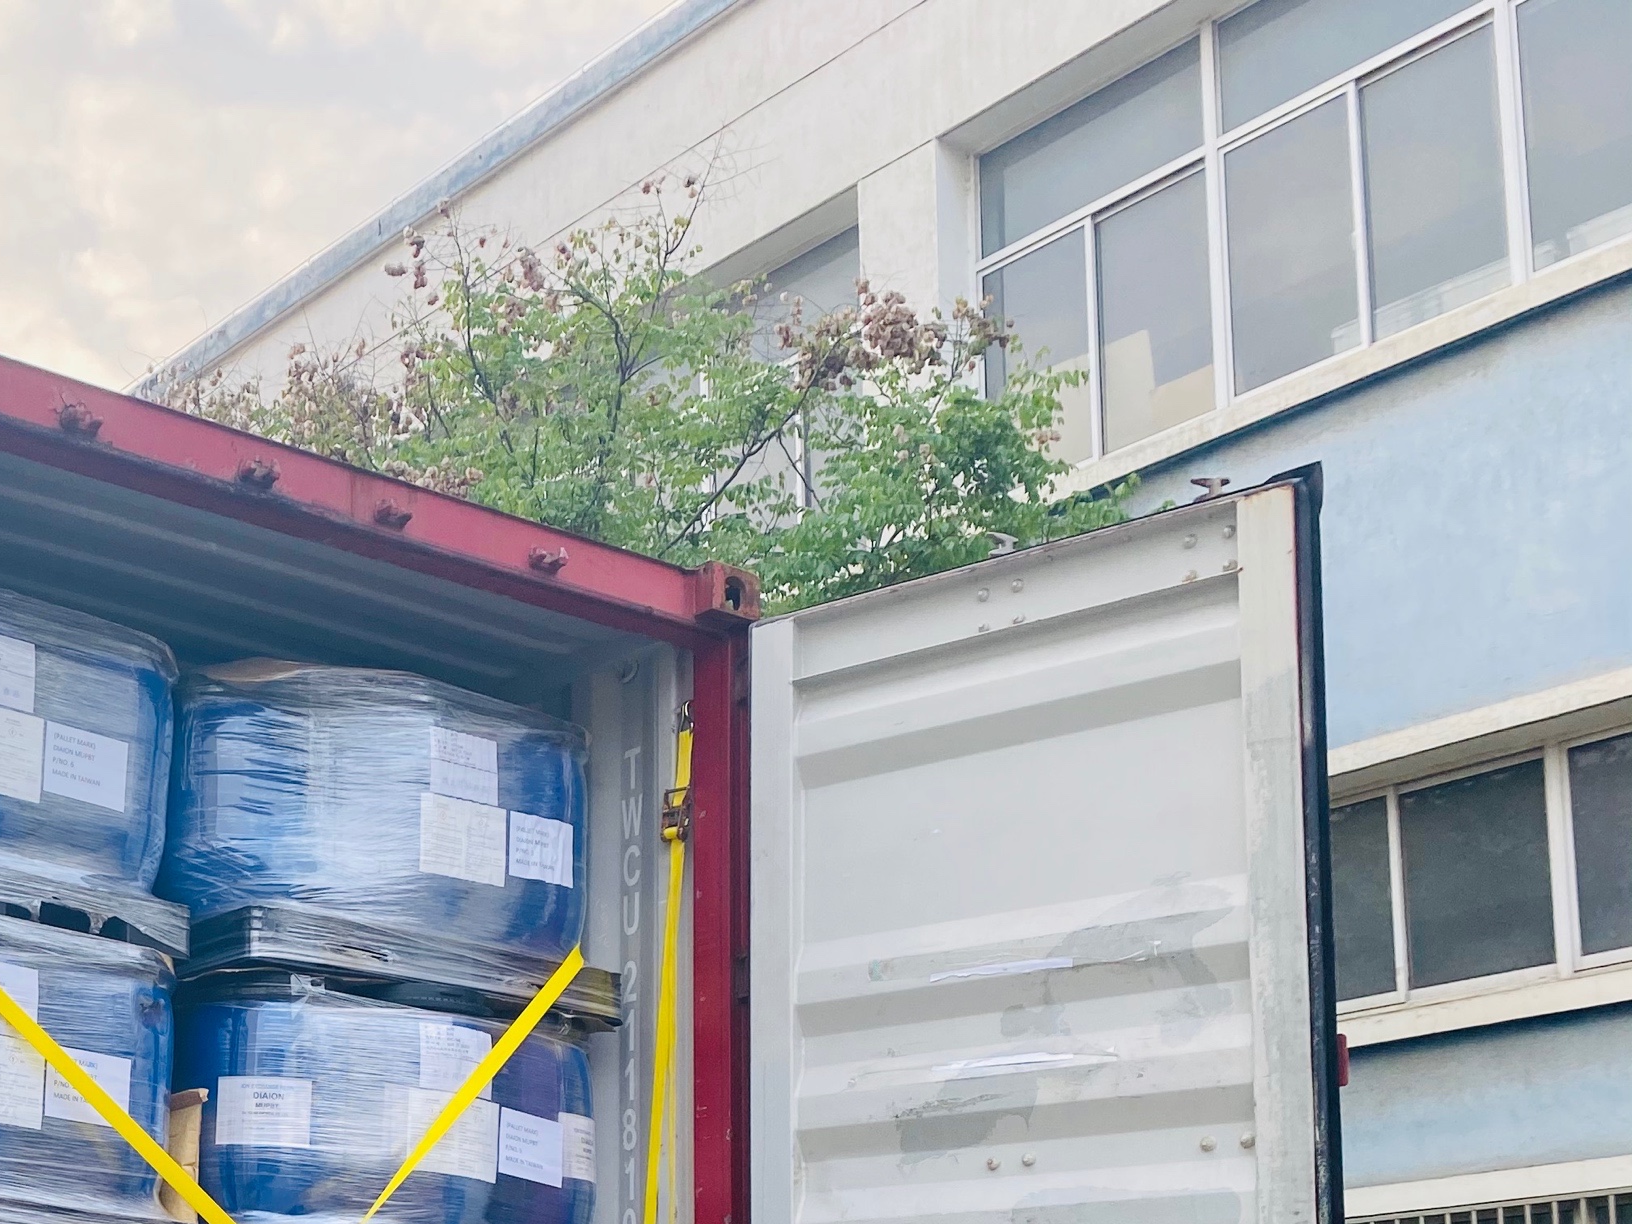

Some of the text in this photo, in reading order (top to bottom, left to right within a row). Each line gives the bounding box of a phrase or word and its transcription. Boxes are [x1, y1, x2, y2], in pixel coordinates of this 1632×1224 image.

[52, 768, 69, 779] MADE
[77, 775, 101, 787] TAIWAN
[621, 746, 643, 936] TWCU
[53, 1092, 71, 1102] MADE
[253, 1091, 285, 1101] DIAION
